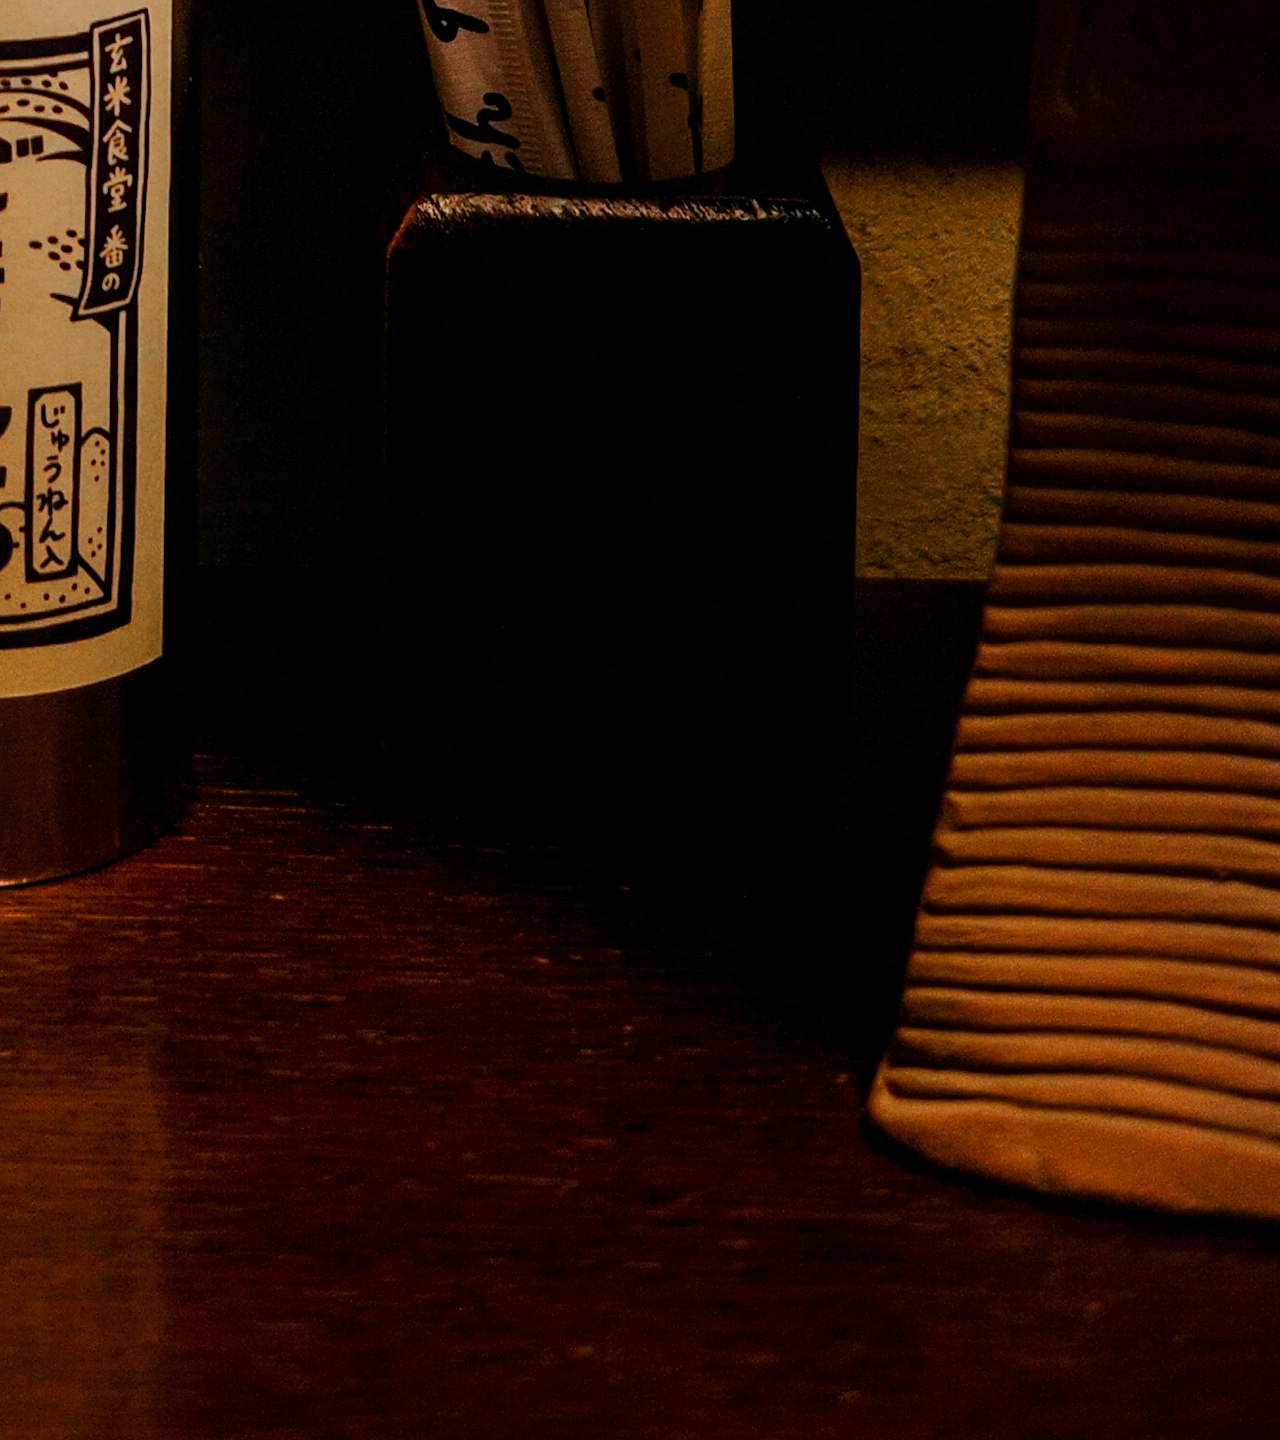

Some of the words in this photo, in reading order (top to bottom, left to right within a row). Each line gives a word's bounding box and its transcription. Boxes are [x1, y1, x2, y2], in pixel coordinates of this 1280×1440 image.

[34, 400, 72, 572] じゅうねん入
